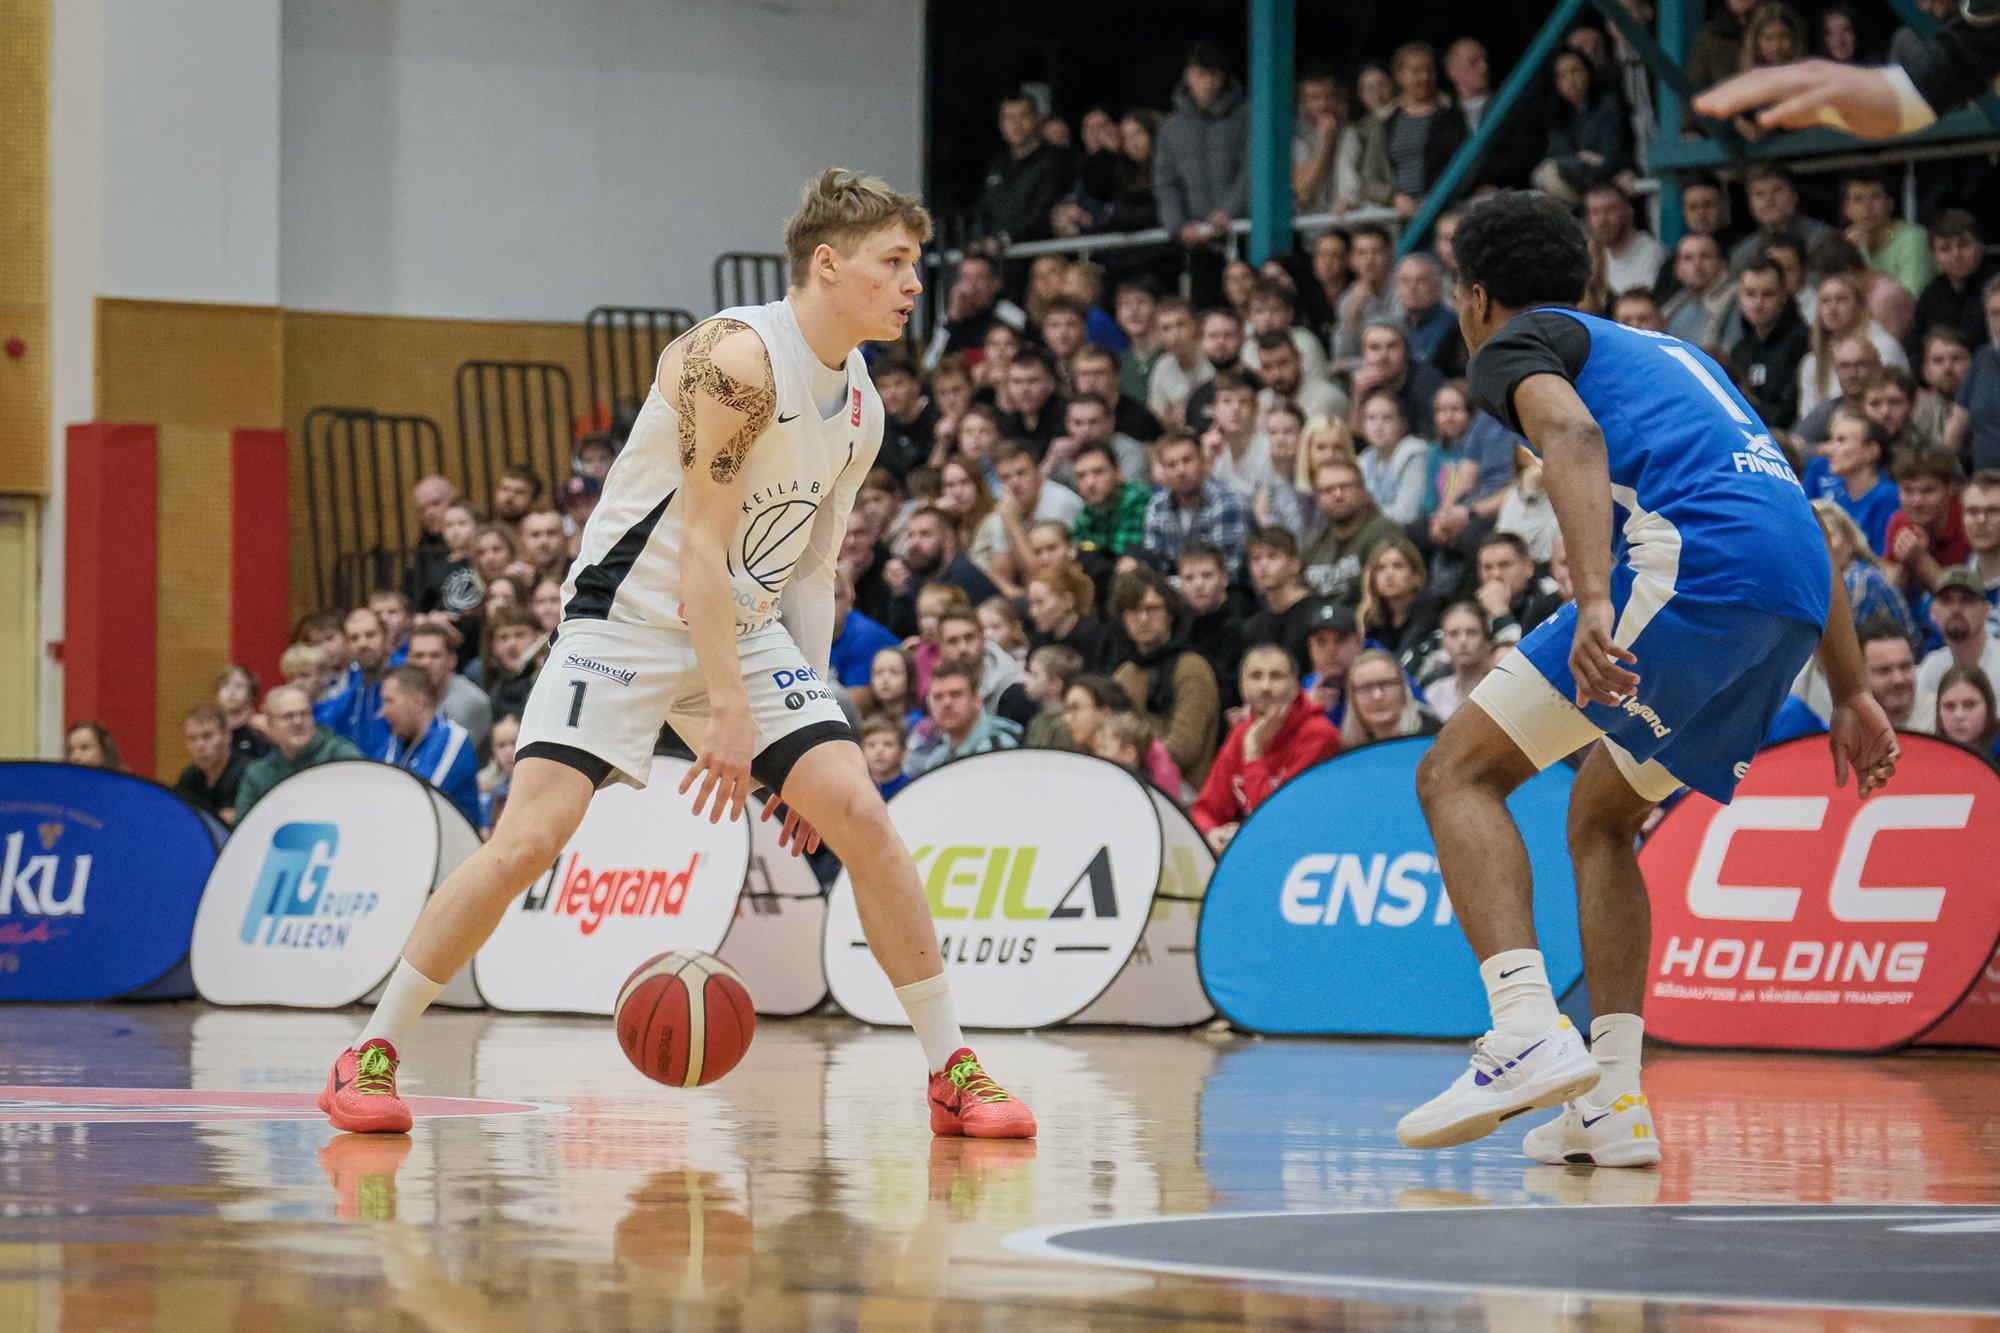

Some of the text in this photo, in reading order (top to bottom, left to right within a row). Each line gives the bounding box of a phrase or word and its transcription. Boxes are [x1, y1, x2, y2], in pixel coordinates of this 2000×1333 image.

[742, 480, 799, 513] KEILA
[565, 653, 637, 682] Scanweld
[566, 680, 589, 729] 1
[1622, 696, 1672, 739] legrand
[1686, 793, 1975, 922] CC
[555, 852, 700, 935] legrand
[913, 845, 1119, 920] EILA
[941, 935, 1037, 963] ALDUS
[1659, 936, 1928, 983] HOLDING
